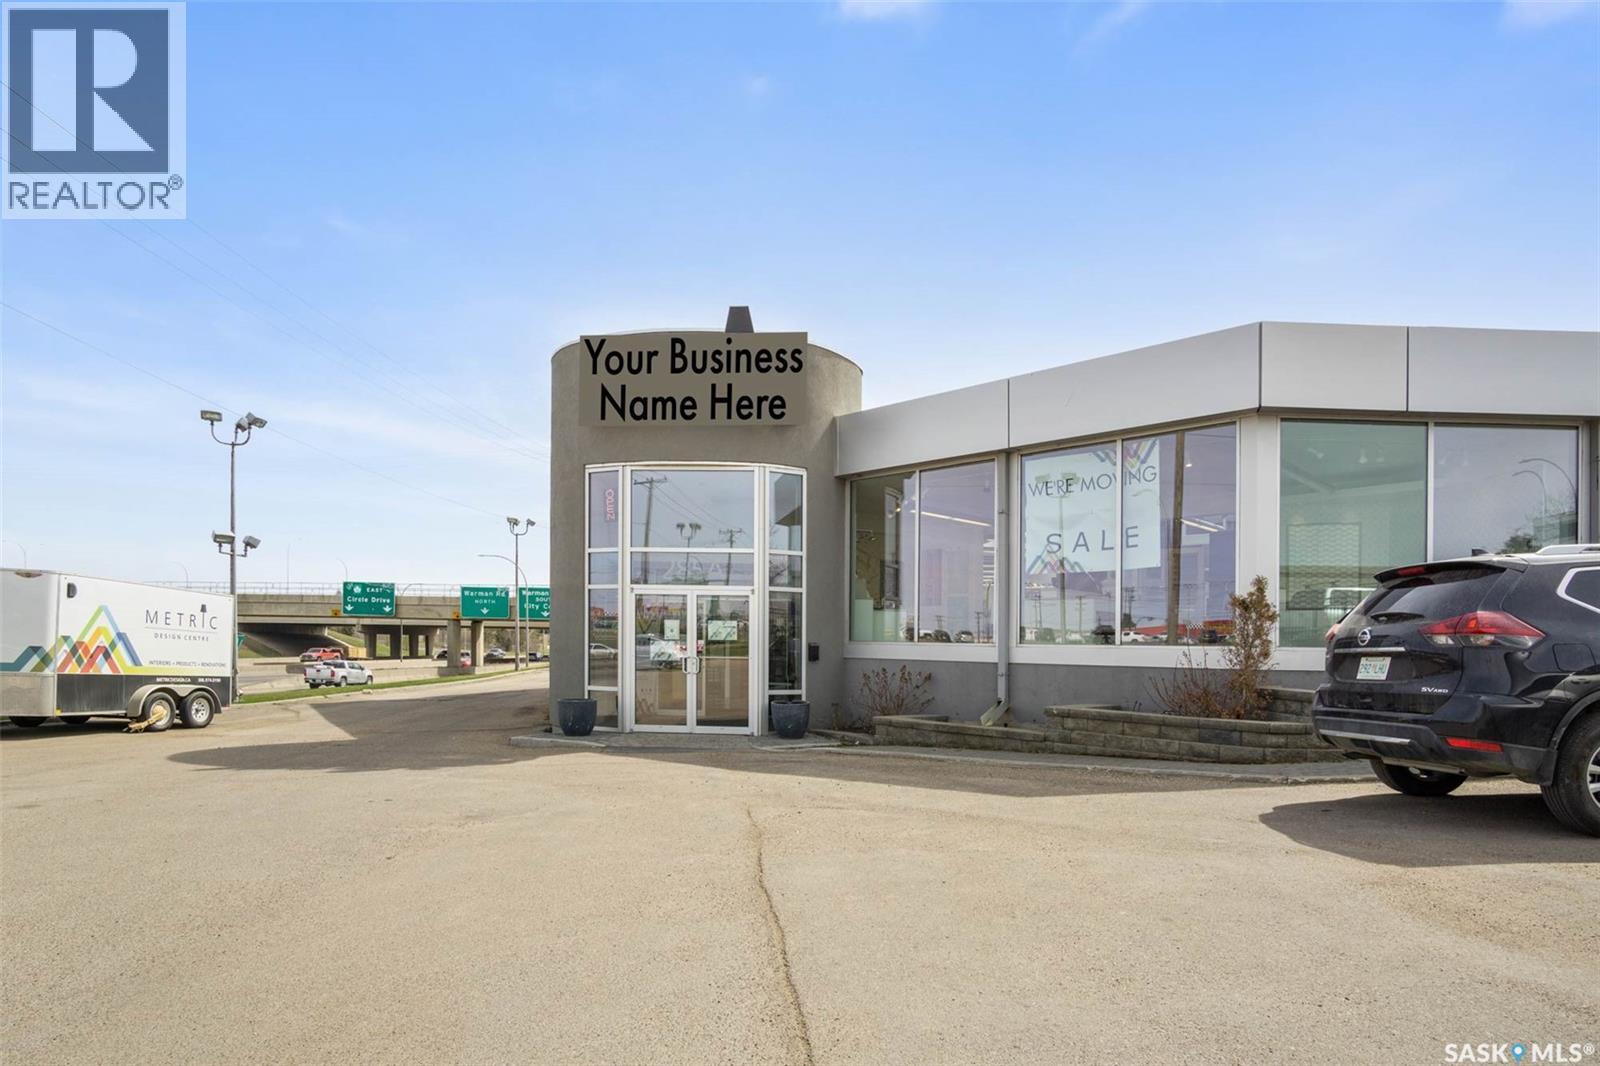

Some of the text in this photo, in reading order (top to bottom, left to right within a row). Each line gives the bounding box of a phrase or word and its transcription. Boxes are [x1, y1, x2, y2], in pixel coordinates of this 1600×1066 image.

[584, 337, 803, 375] Your Business
[600, 382, 786, 422] Name Here
[1028, 478, 1074, 497] WE'RE
[1046, 526, 1139, 554] SALE
[347, 595, 368, 603] Circle
[145, 605, 218, 630] METRIC
[154, 632, 209, 642] DESIGN CENTRE
